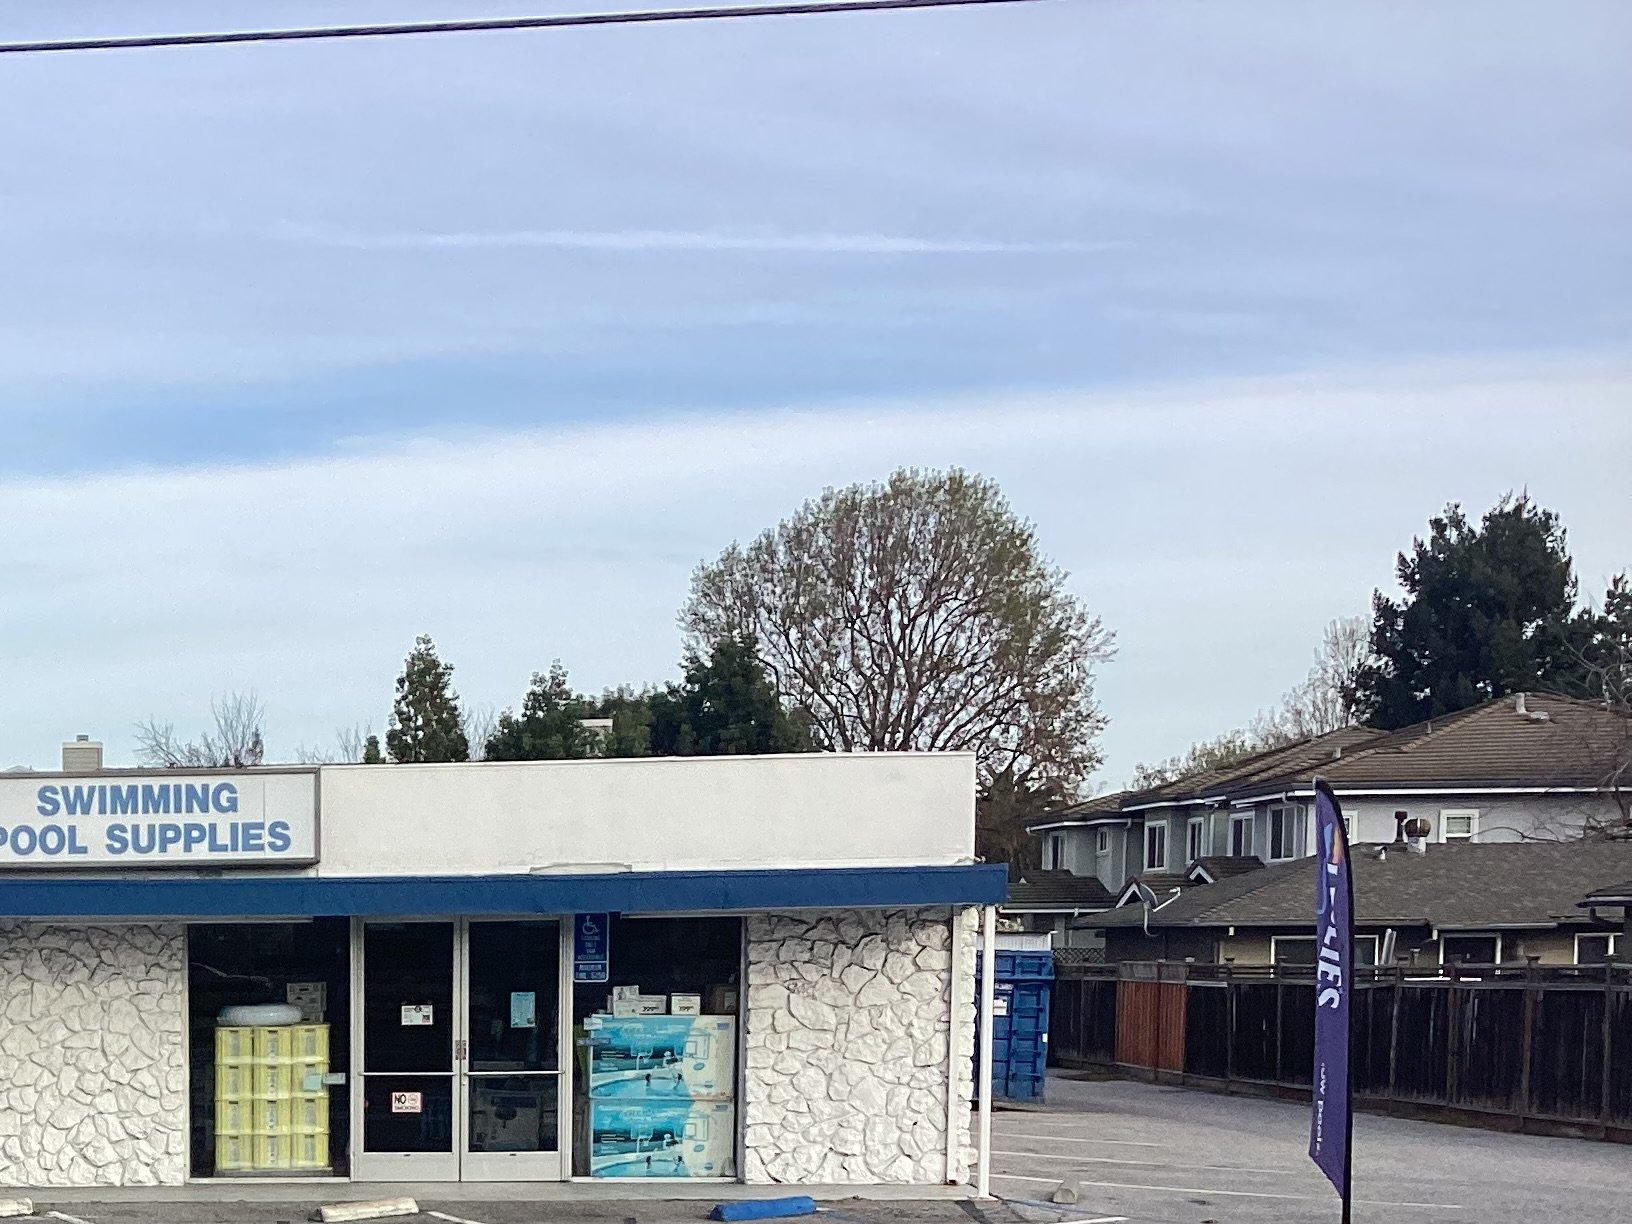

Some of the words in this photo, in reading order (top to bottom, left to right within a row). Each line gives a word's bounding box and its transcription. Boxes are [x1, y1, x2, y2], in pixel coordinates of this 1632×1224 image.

[37, 783, 238, 815] SWIMMING
[105, 820, 291, 853] SUPPLIES
[395, 1094, 406, 1104] NO
